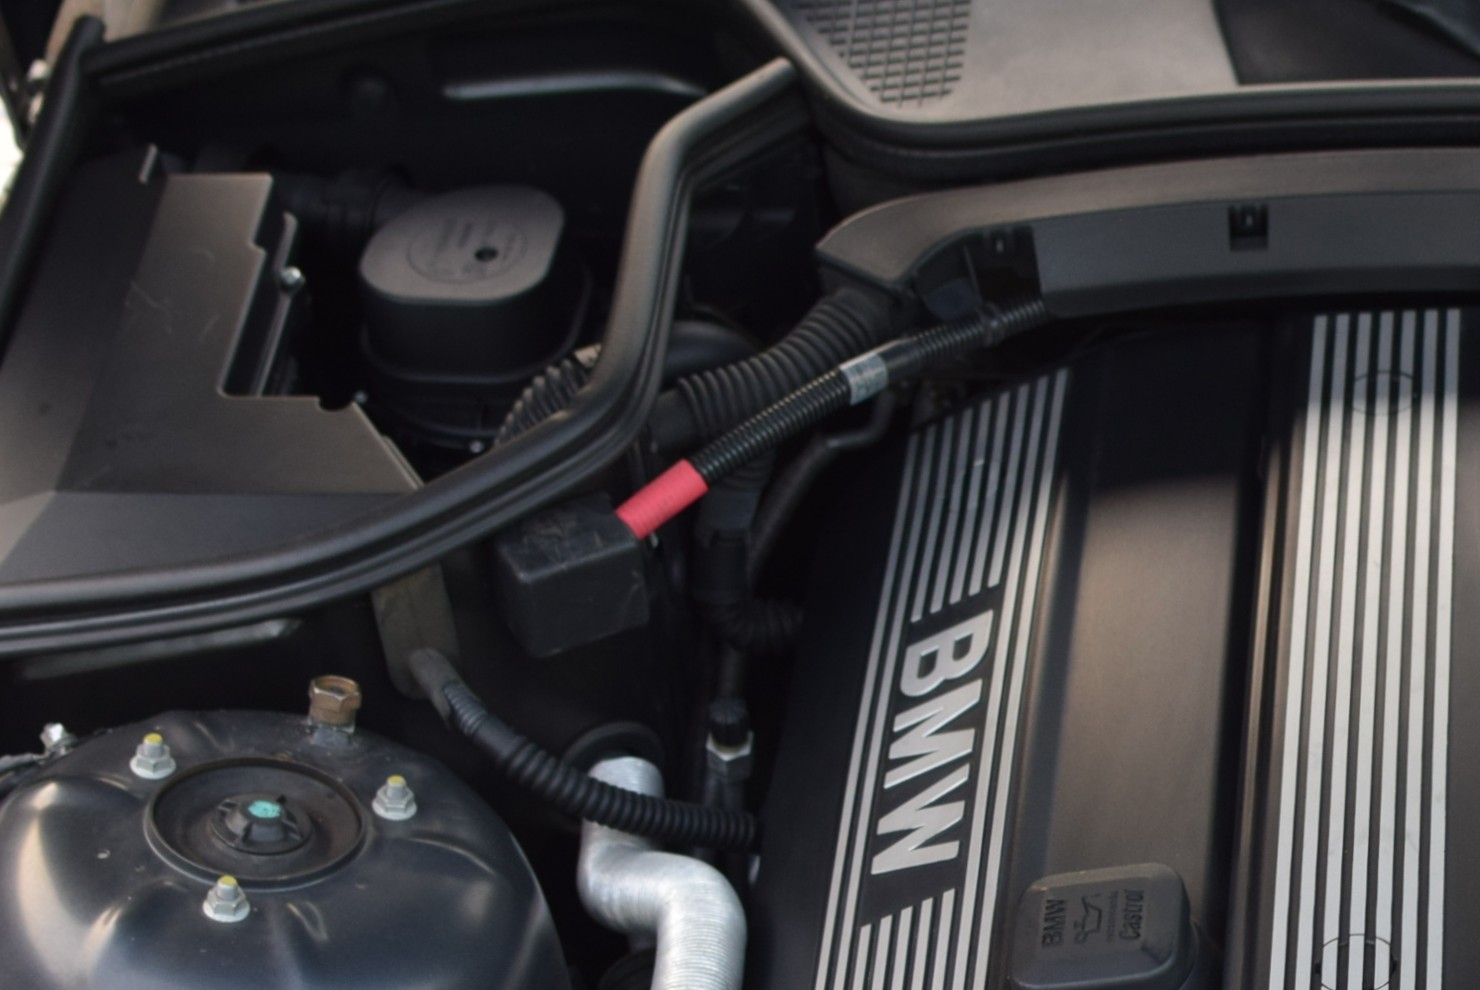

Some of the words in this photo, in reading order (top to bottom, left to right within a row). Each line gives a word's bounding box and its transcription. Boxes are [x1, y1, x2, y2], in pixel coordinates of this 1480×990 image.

[871, 609, 994, 875] BMW
[1042, 899, 1067, 947] BMW
[1120, 889, 1144, 940] Castrol
